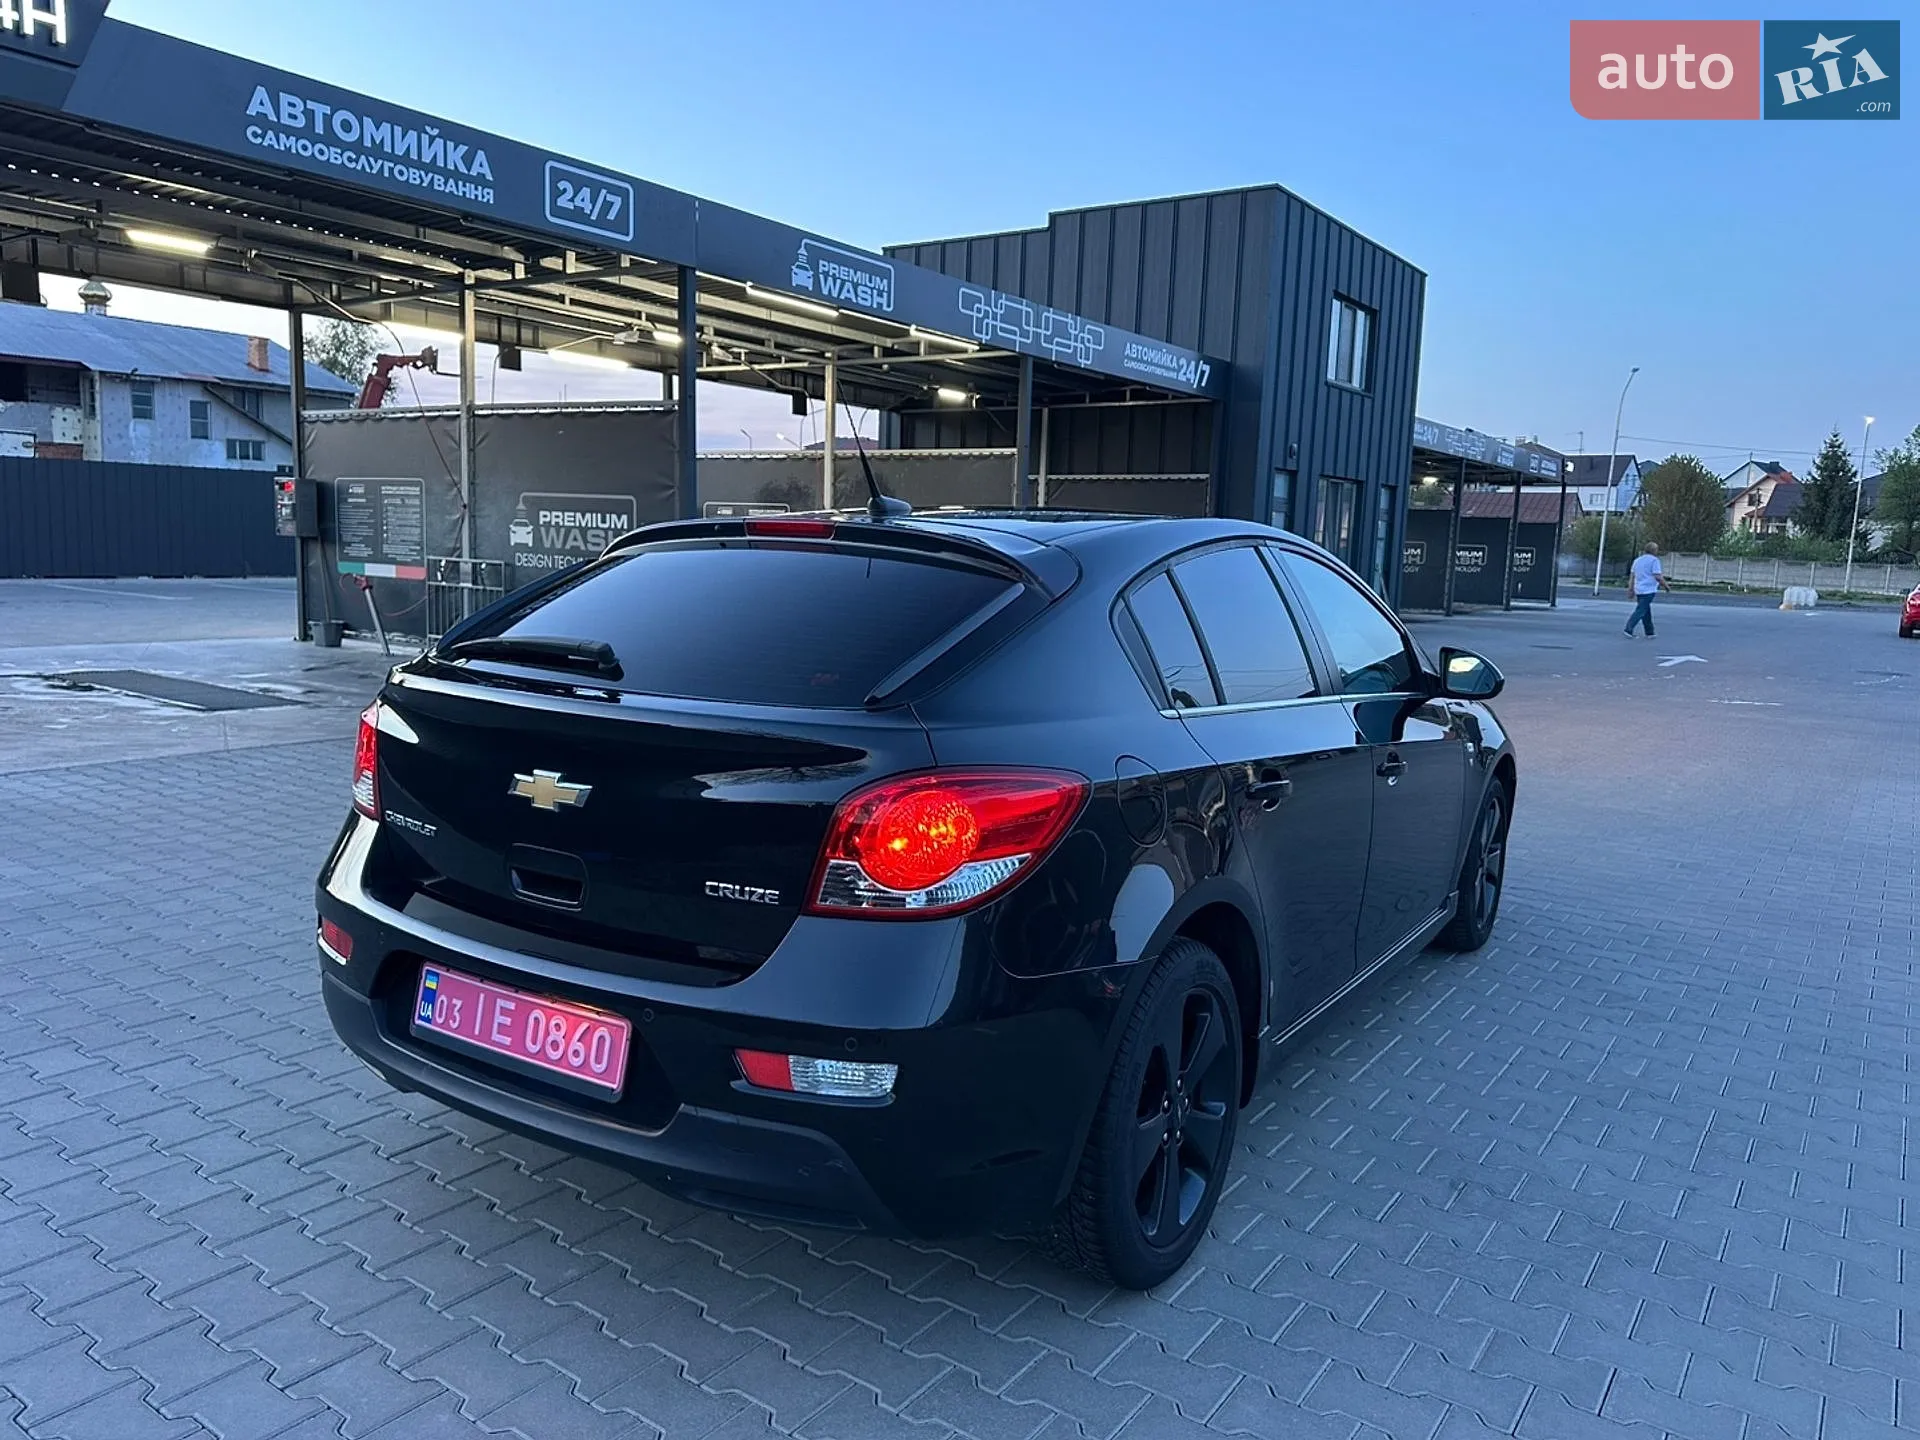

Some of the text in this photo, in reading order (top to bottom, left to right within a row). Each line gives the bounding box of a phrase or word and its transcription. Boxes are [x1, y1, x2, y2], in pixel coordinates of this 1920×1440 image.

[246, 85, 494, 181] АВТОМИЙКА
[246, 125, 495, 204] САМООБСЛУГОВУВАННЯ
[556, 180, 622, 220] 24/7
[818, 259, 888, 292] PREMIUM
[819, 274, 889, 311] WASH
[1124, 342, 1178, 369] АВТОМИЙКА
[1178, 357, 1211, 389] 24/7
[539, 510, 628, 529] PREMIUM
[515, 552, 552, 568] DESIGN
[705, 881, 780, 904] CRUZE
[419, 1001, 433, 1020] UA
[435, 992, 612, 1074] 03 IE 0860
